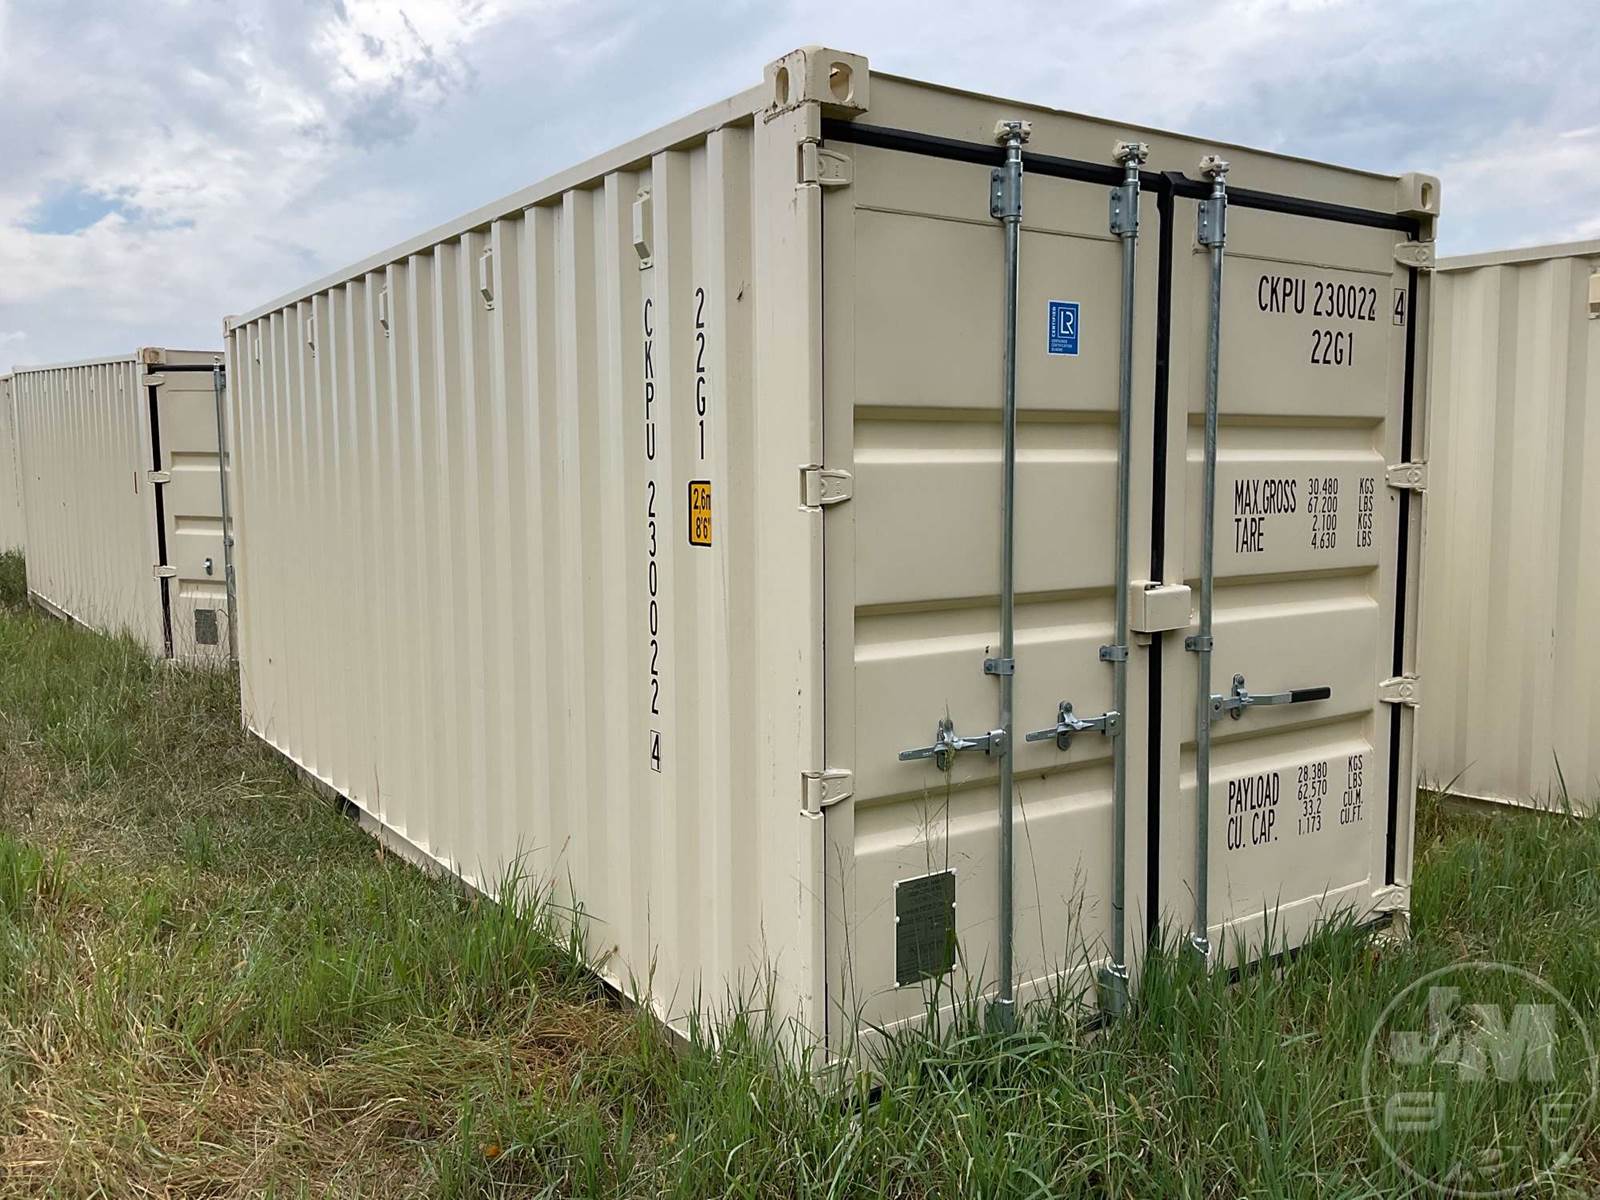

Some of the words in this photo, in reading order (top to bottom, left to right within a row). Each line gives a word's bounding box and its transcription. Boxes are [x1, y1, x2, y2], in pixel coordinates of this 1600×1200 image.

[1258, 275, 1305, 314] CKPU
[1313, 281, 1376, 320] 230022
[1395, 291, 1404, 324] 4
[1311, 329, 1353, 366] 22G1
[644, 298, 655, 460] CKPU
[696, 287, 706, 460] 22G1
[1235, 479, 1297, 515] MAX.GROSS
[1308, 478, 1338, 495] 30.480
[1359, 478, 1375, 495] KGS
[1307, 496, 1338, 513] 67.200
[1358, 496, 1374, 513] LBS
[1234, 517, 1265, 553] TARE
[1312, 514, 1337, 531] 2.100
[1357, 513, 1373, 530] KGS
[1311, 532, 1336, 549] 4.630
[1356, 531, 1372, 547] LBS
[648, 480, 658, 715] 230022
[1228, 772, 1280, 815] PAYLOAD
[1297, 761, 1328, 784] 28.380
[1348, 754, 1364, 773] KGS
[1297, 779, 1328, 801] 62.570
[1347, 771, 1363, 790] LBS
[1303, 798, 1322, 817] 33.2
[1343, 788, 1364, 808] CU.M.
[1227, 815, 1246, 851] CU.
[1251, 809, 1279, 845] CAP.
[1298, 815, 1322, 836] 1.173
[1340, 805, 1363, 825] CU.FT.
